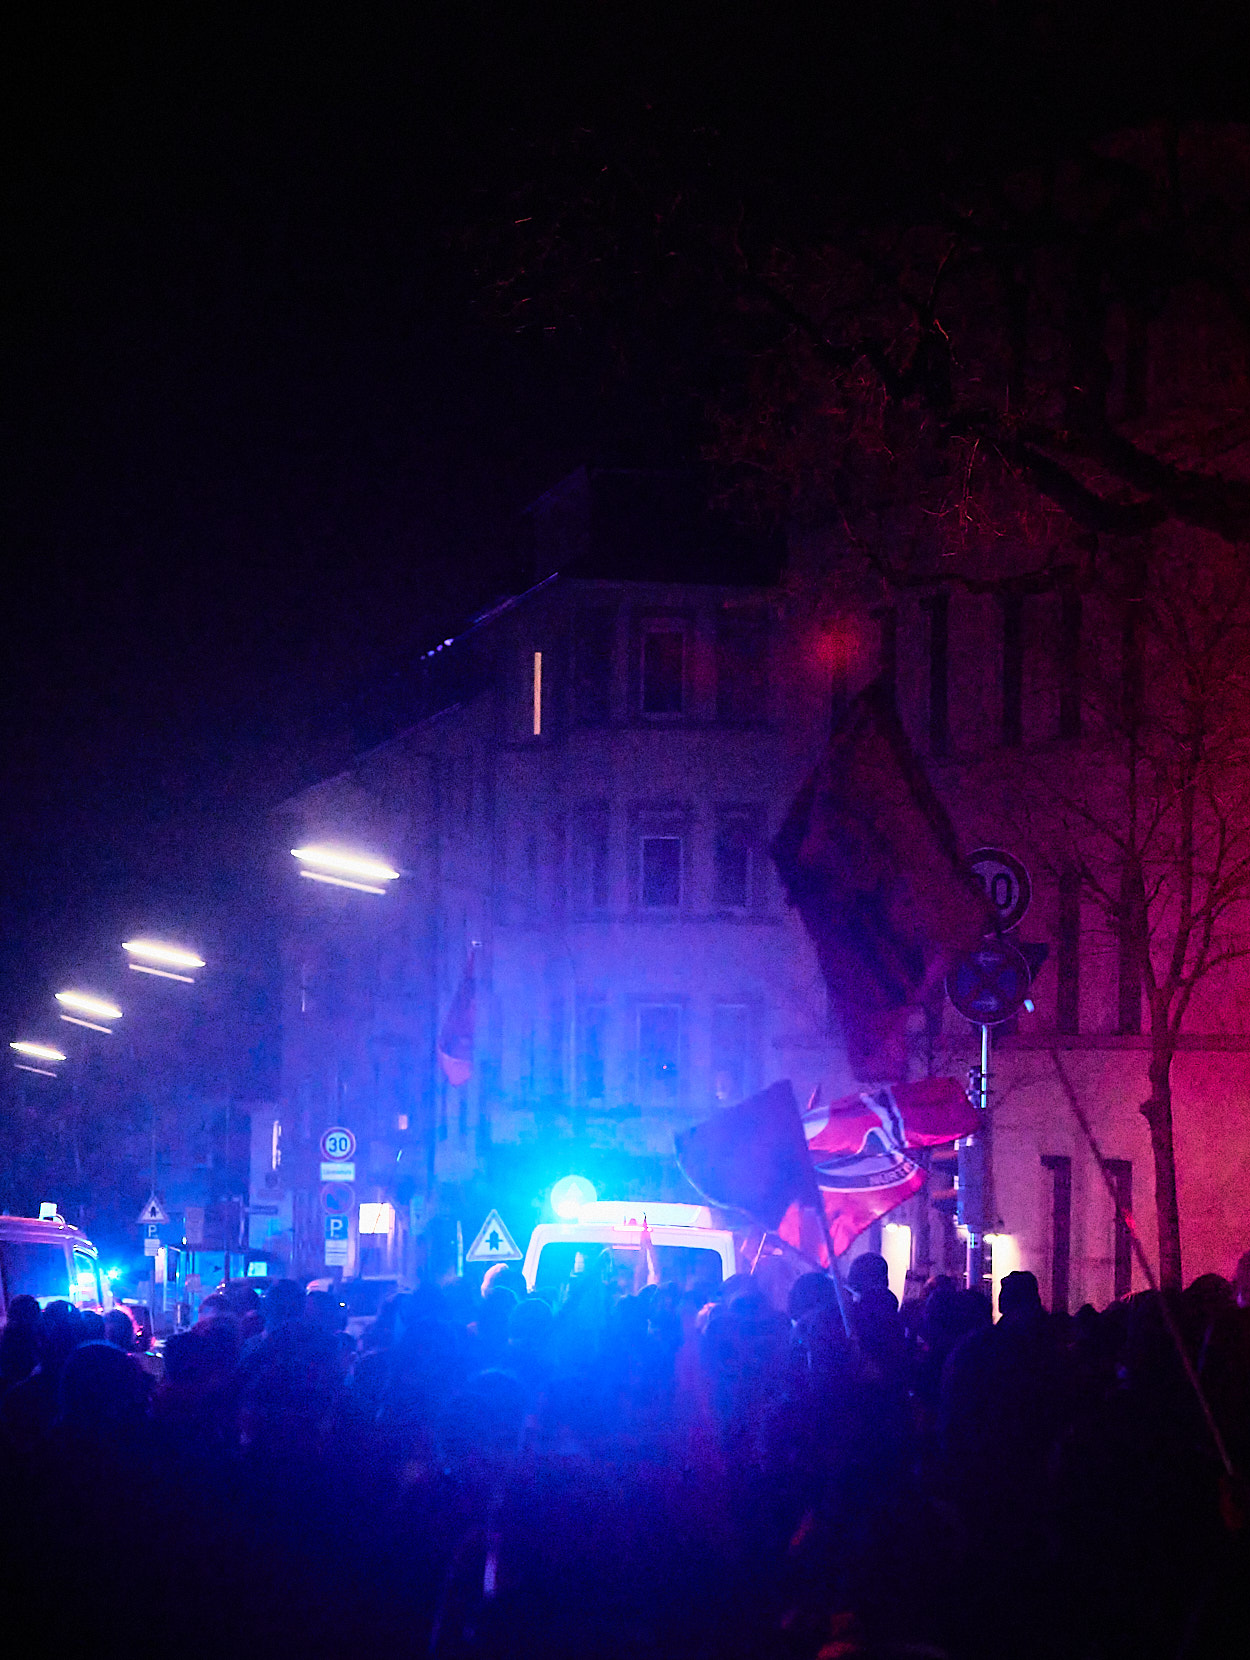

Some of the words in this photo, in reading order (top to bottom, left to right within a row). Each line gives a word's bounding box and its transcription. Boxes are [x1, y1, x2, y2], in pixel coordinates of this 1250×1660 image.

[328, 1136, 348, 1152] 30
[148, 1224, 157, 1238] P
[330, 1218, 343, 1237] P
